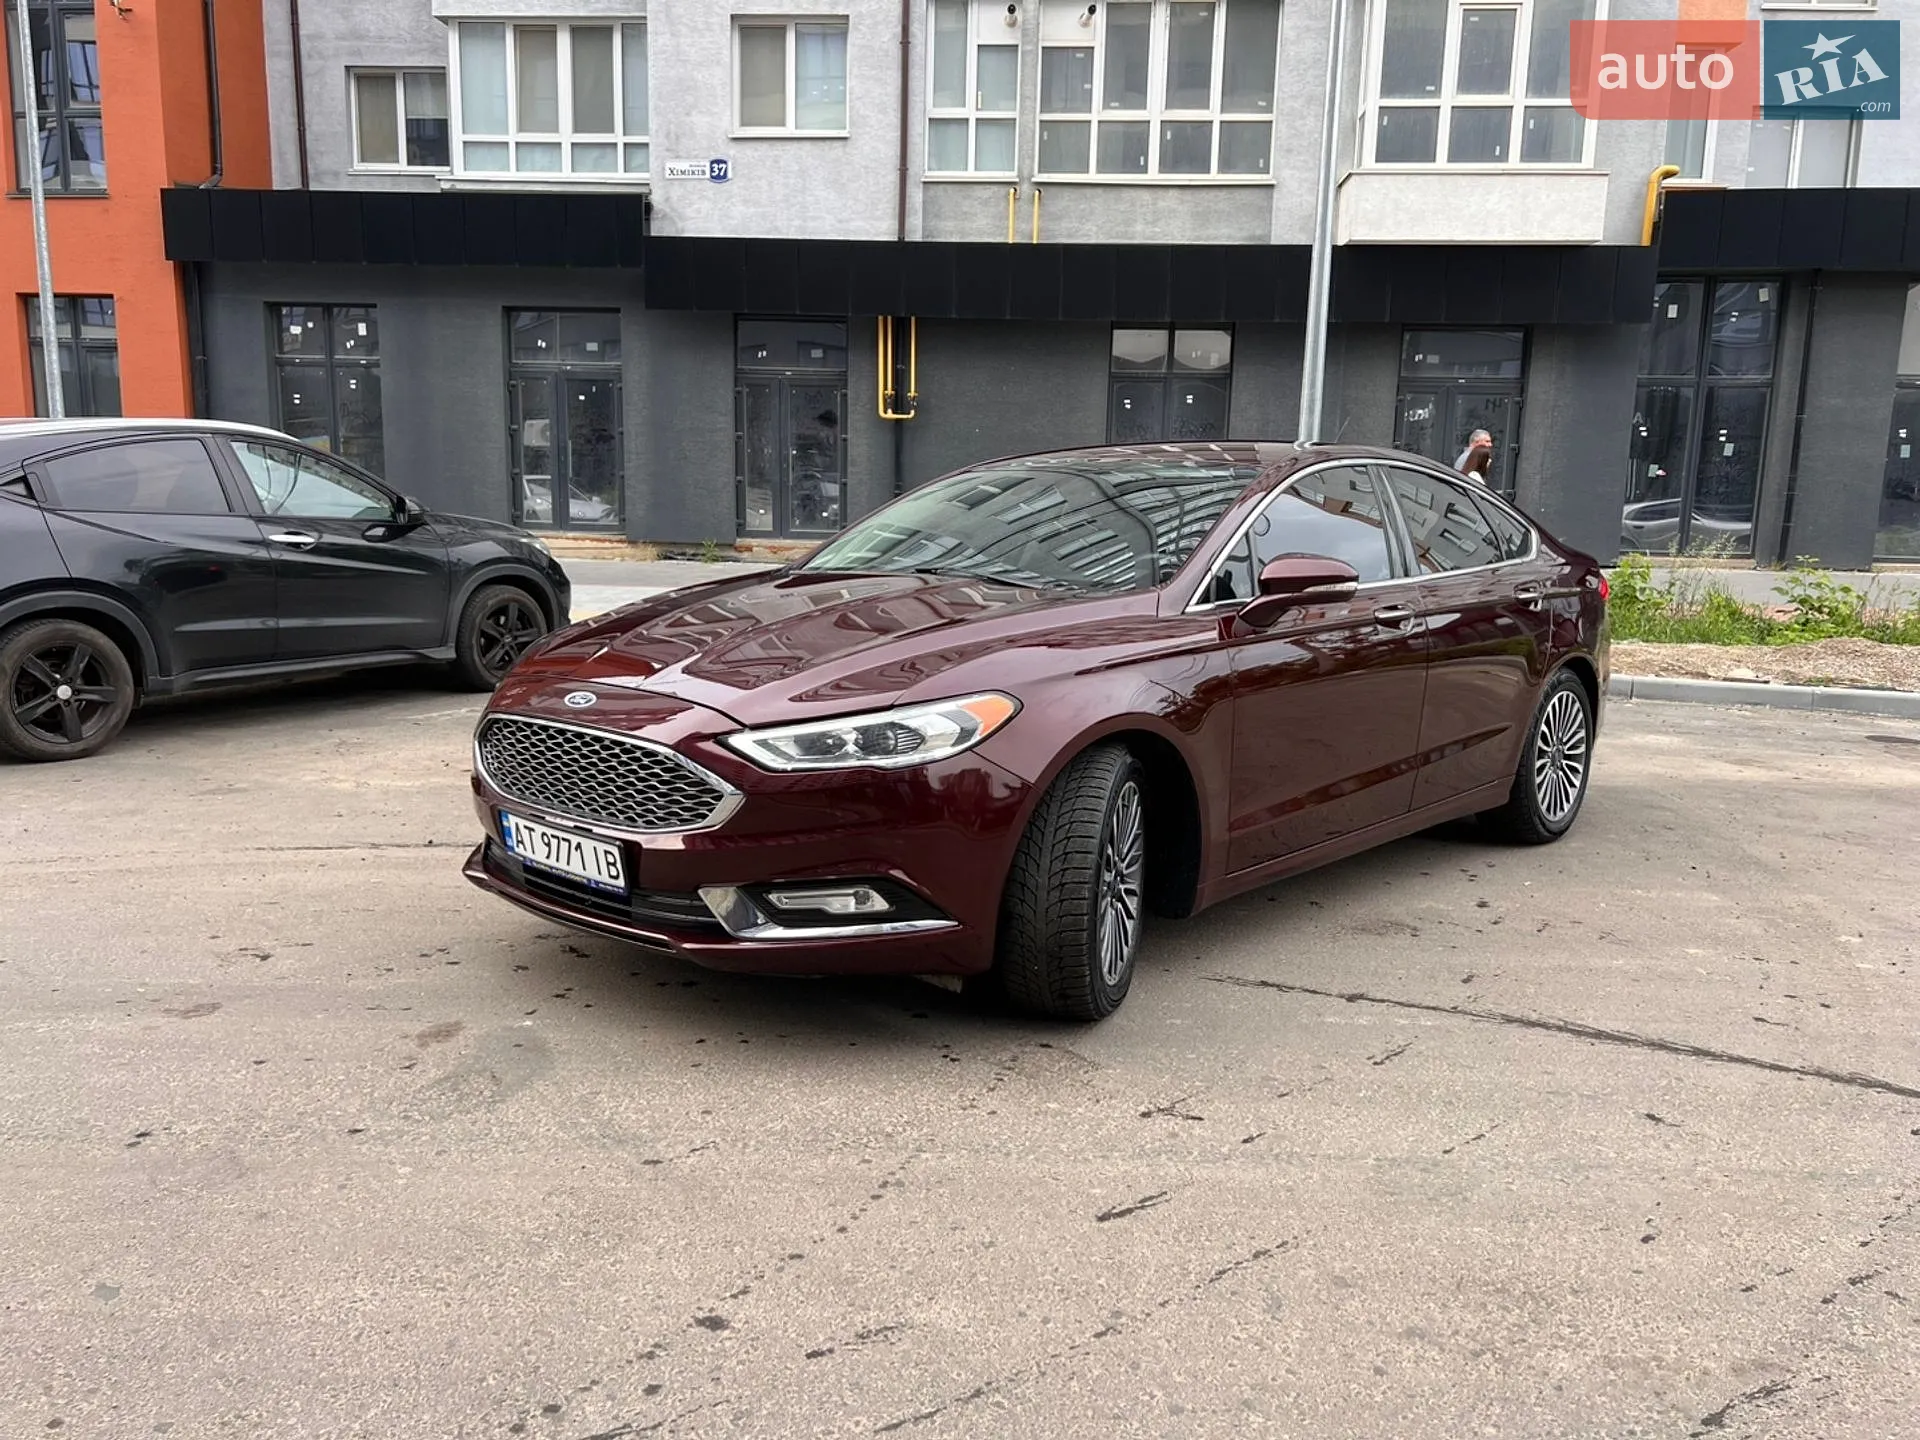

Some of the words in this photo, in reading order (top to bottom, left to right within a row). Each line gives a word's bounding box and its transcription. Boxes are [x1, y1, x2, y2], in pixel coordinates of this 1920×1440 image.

[711, 163, 727, 176] 37
[514, 821, 536, 855] AT
[541, 831, 587, 871] 9771
[593, 846, 620, 880] IB
